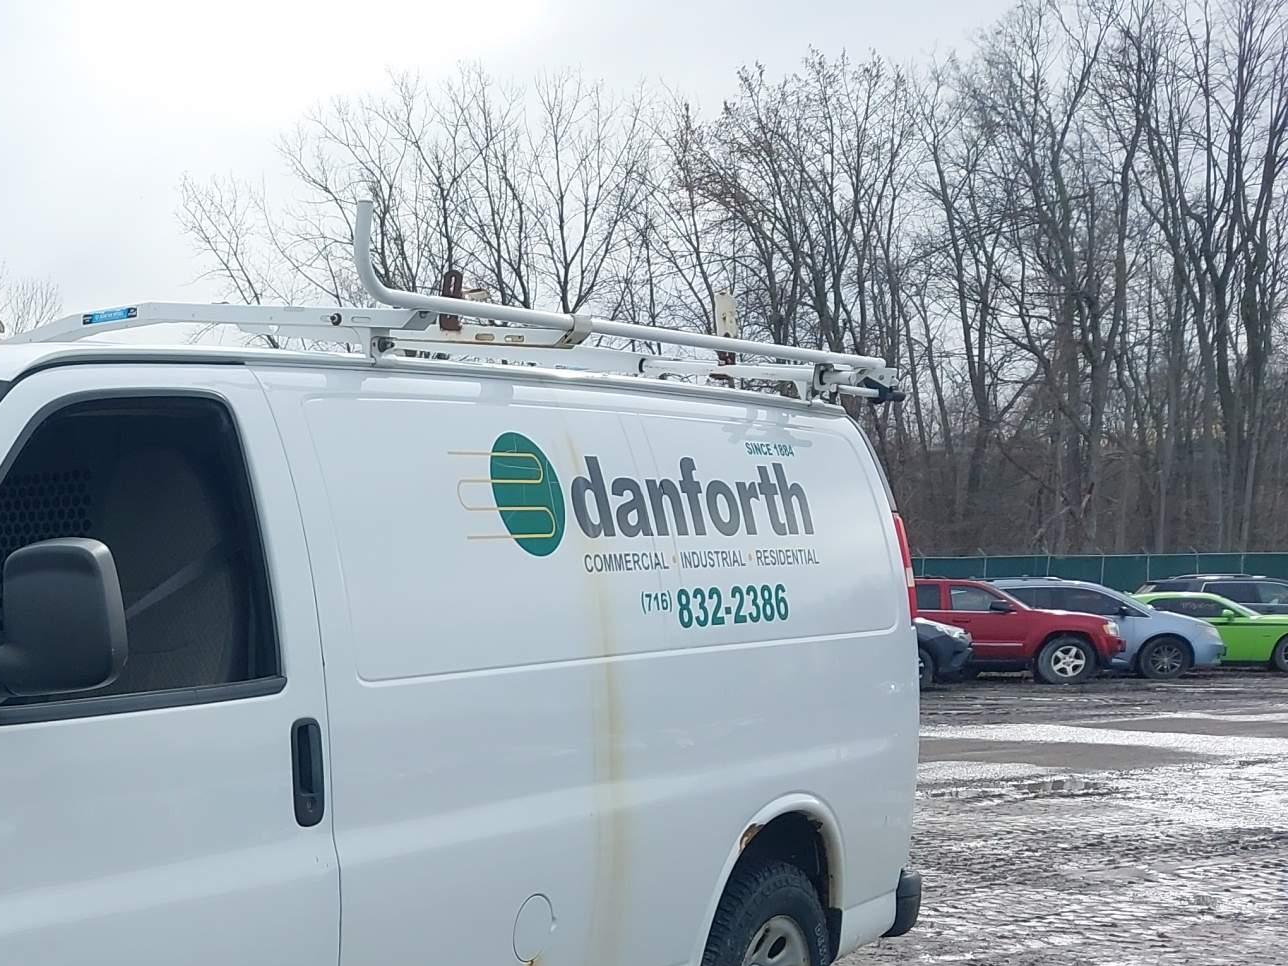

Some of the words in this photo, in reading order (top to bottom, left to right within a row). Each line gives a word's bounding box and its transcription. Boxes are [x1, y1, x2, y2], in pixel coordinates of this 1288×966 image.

[745, 441, 772, 456] SINCE
[773, 443, 794, 457] 1884
[570, 455, 814, 539] danforth
[584, 551, 669, 573] COMMERCIAL
[680, 549, 746, 569] INDUSTRIAL
[755, 549, 820, 567] RESIDENTIAL
[641, 591, 673, 615] (716)
[676, 583, 789, 629] 832-2386
